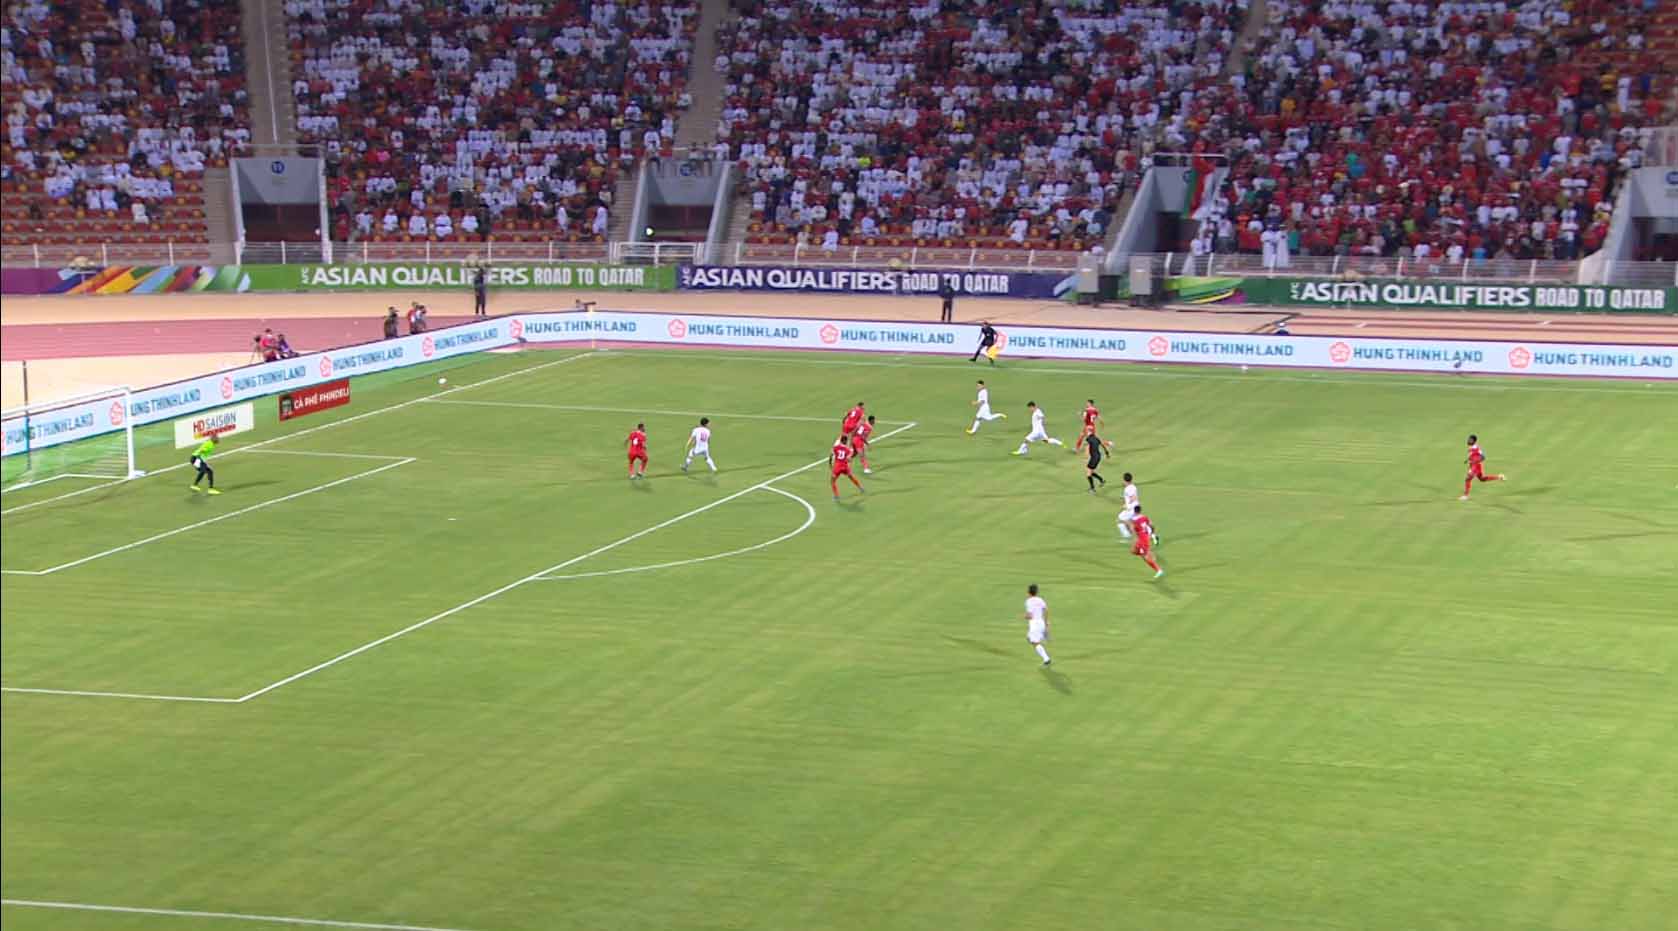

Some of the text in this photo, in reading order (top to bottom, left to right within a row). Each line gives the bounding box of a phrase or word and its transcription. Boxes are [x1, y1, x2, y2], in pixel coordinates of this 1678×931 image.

[311, 267, 387, 285] ASIAN
[391, 267, 529, 286] QUALIFERS
[534, 267, 571, 285] ROAD
[576, 268, 594, 285] TO
[599, 268, 644, 286] QATAR
[691, 268, 763, 286] ASIAN
[767, 269, 896, 290] QUALIFIERS
[902, 273, 938, 291] ROAD
[964, 274, 1008, 292] QATAR
[1300, 282, 1378, 302] ASIAN
[1382, 284, 1530, 306] QUALIFIERS
[1535, 287, 1579, 307] ROAD
[1584, 288, 1605, 308] TO
[1610, 289, 1665, 309] QATAR
[193, 419, 205, 433] HD
